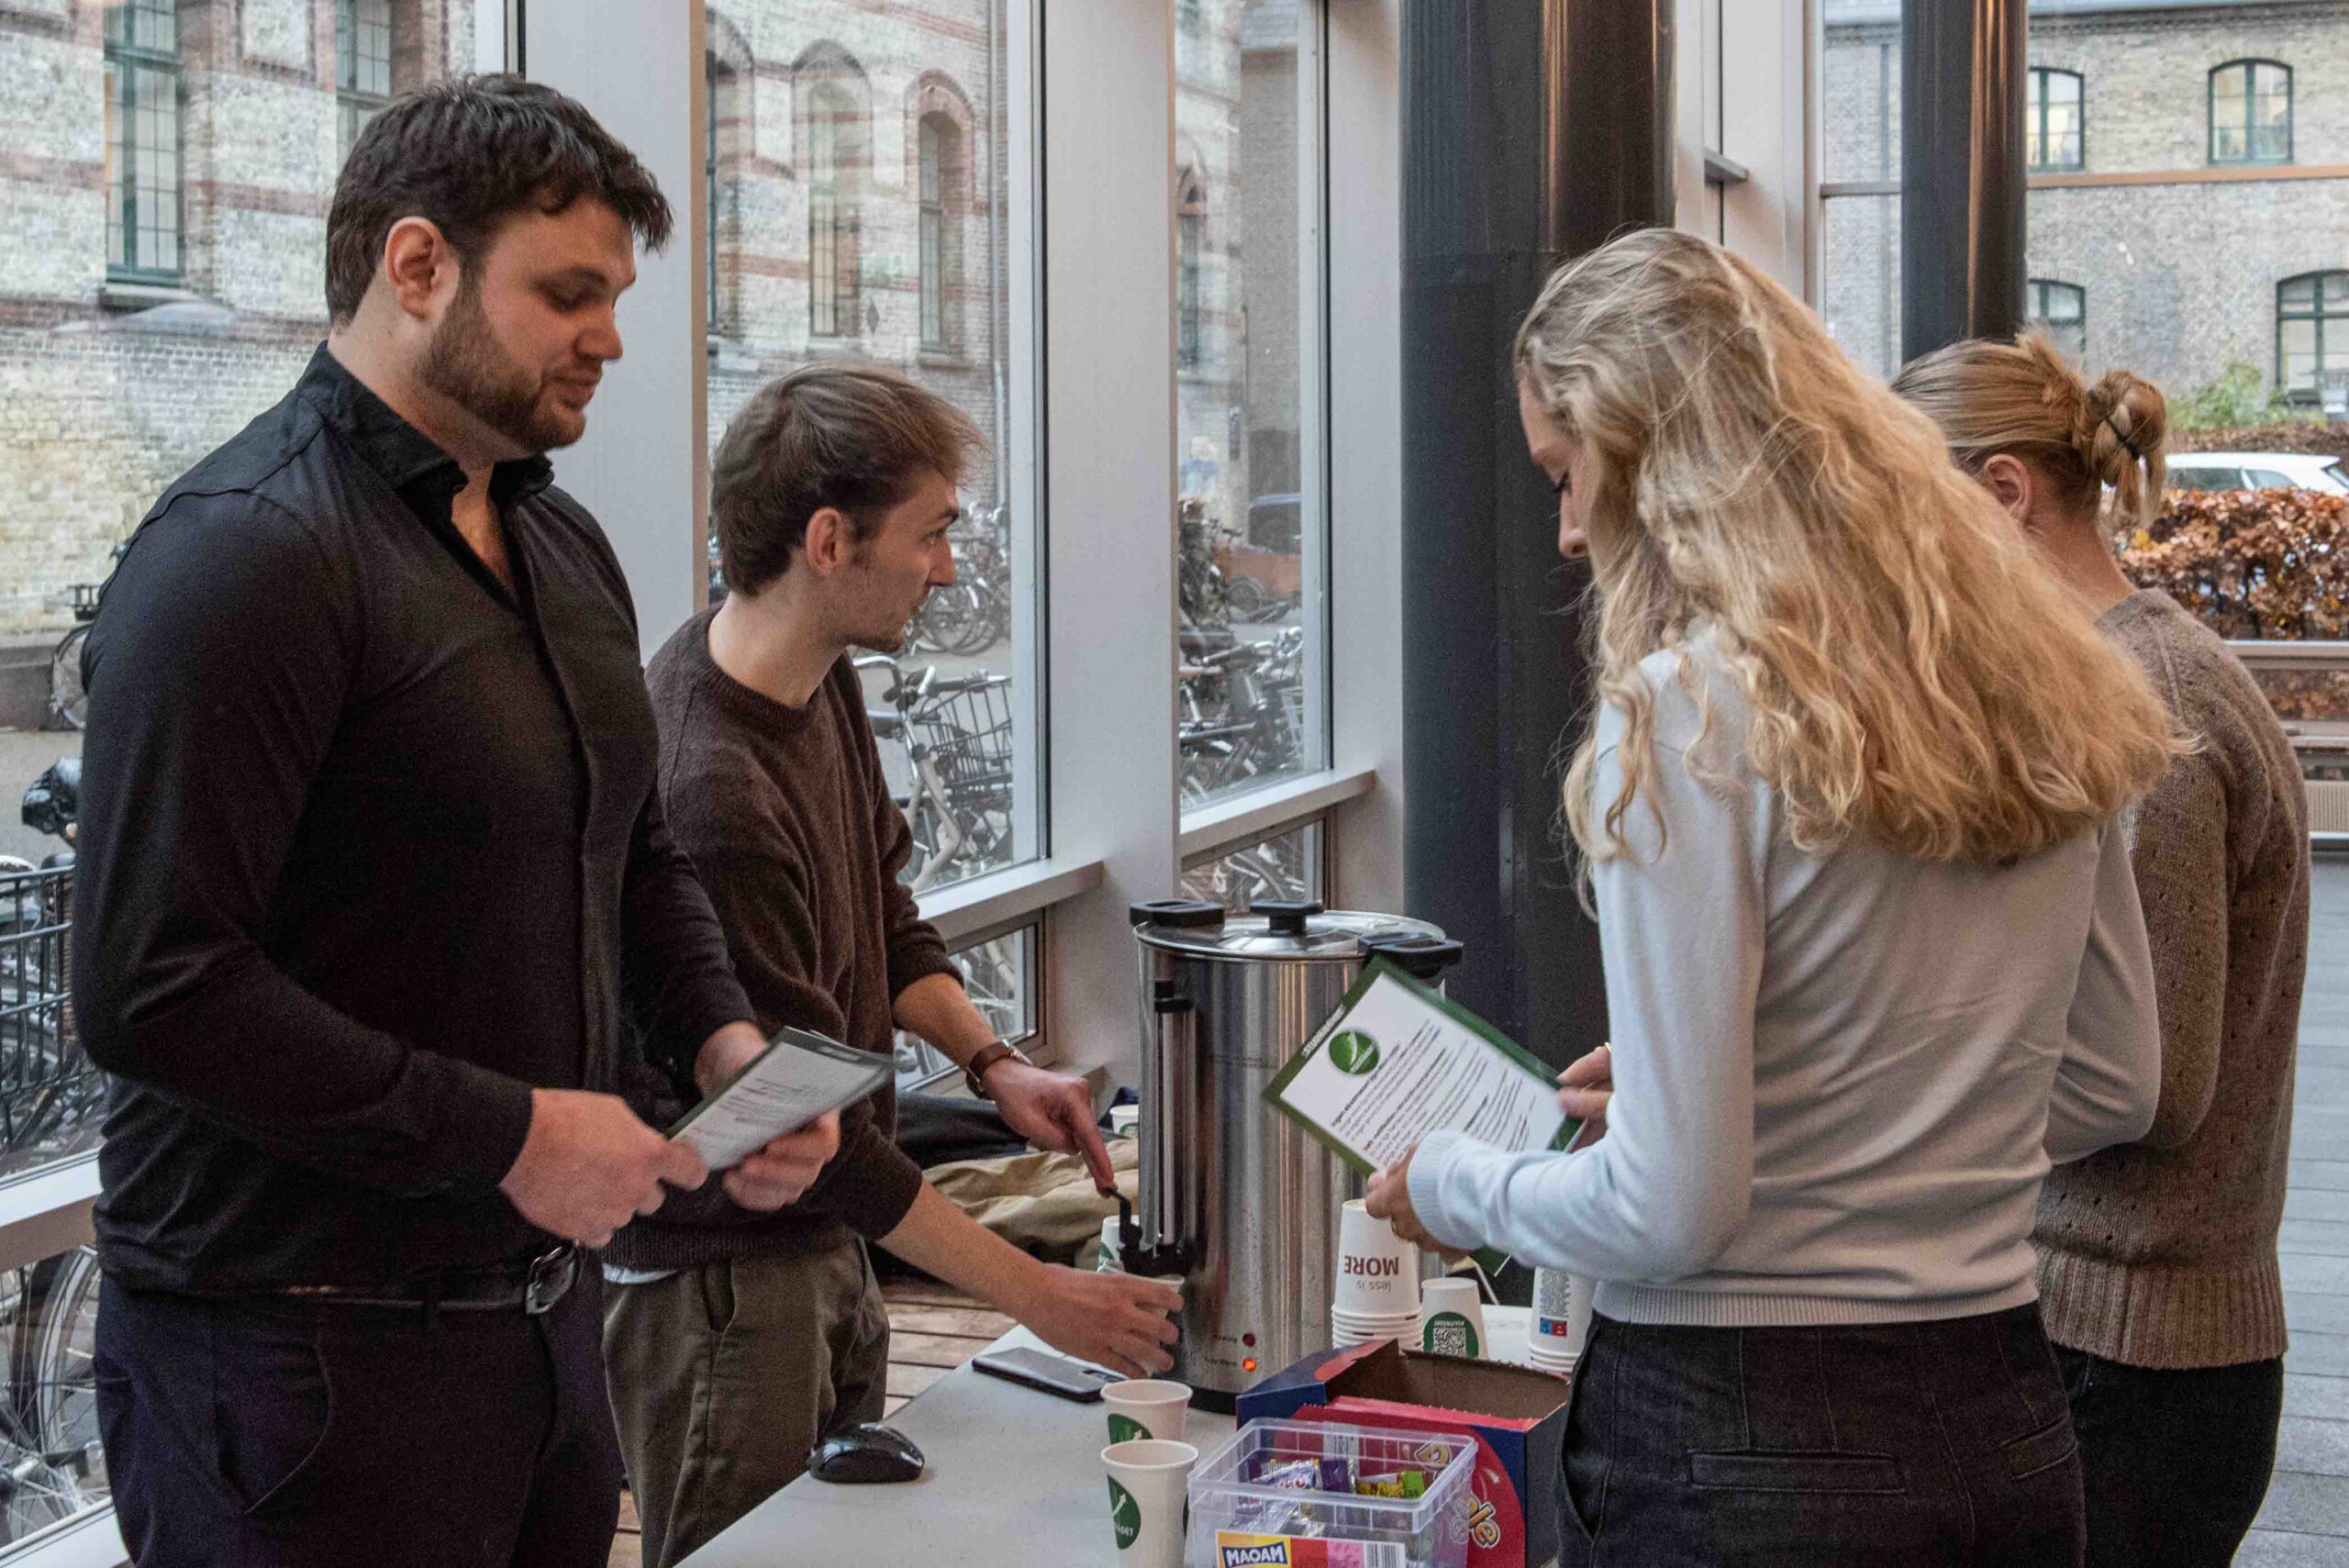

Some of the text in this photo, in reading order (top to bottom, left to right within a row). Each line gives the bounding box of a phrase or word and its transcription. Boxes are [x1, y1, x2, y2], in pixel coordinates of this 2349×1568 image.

[1343, 1255, 1399, 1276] MORE
[1356, 1281, 1391, 1294] less is
[1225, 1543, 1285, 1567] MAOAM
